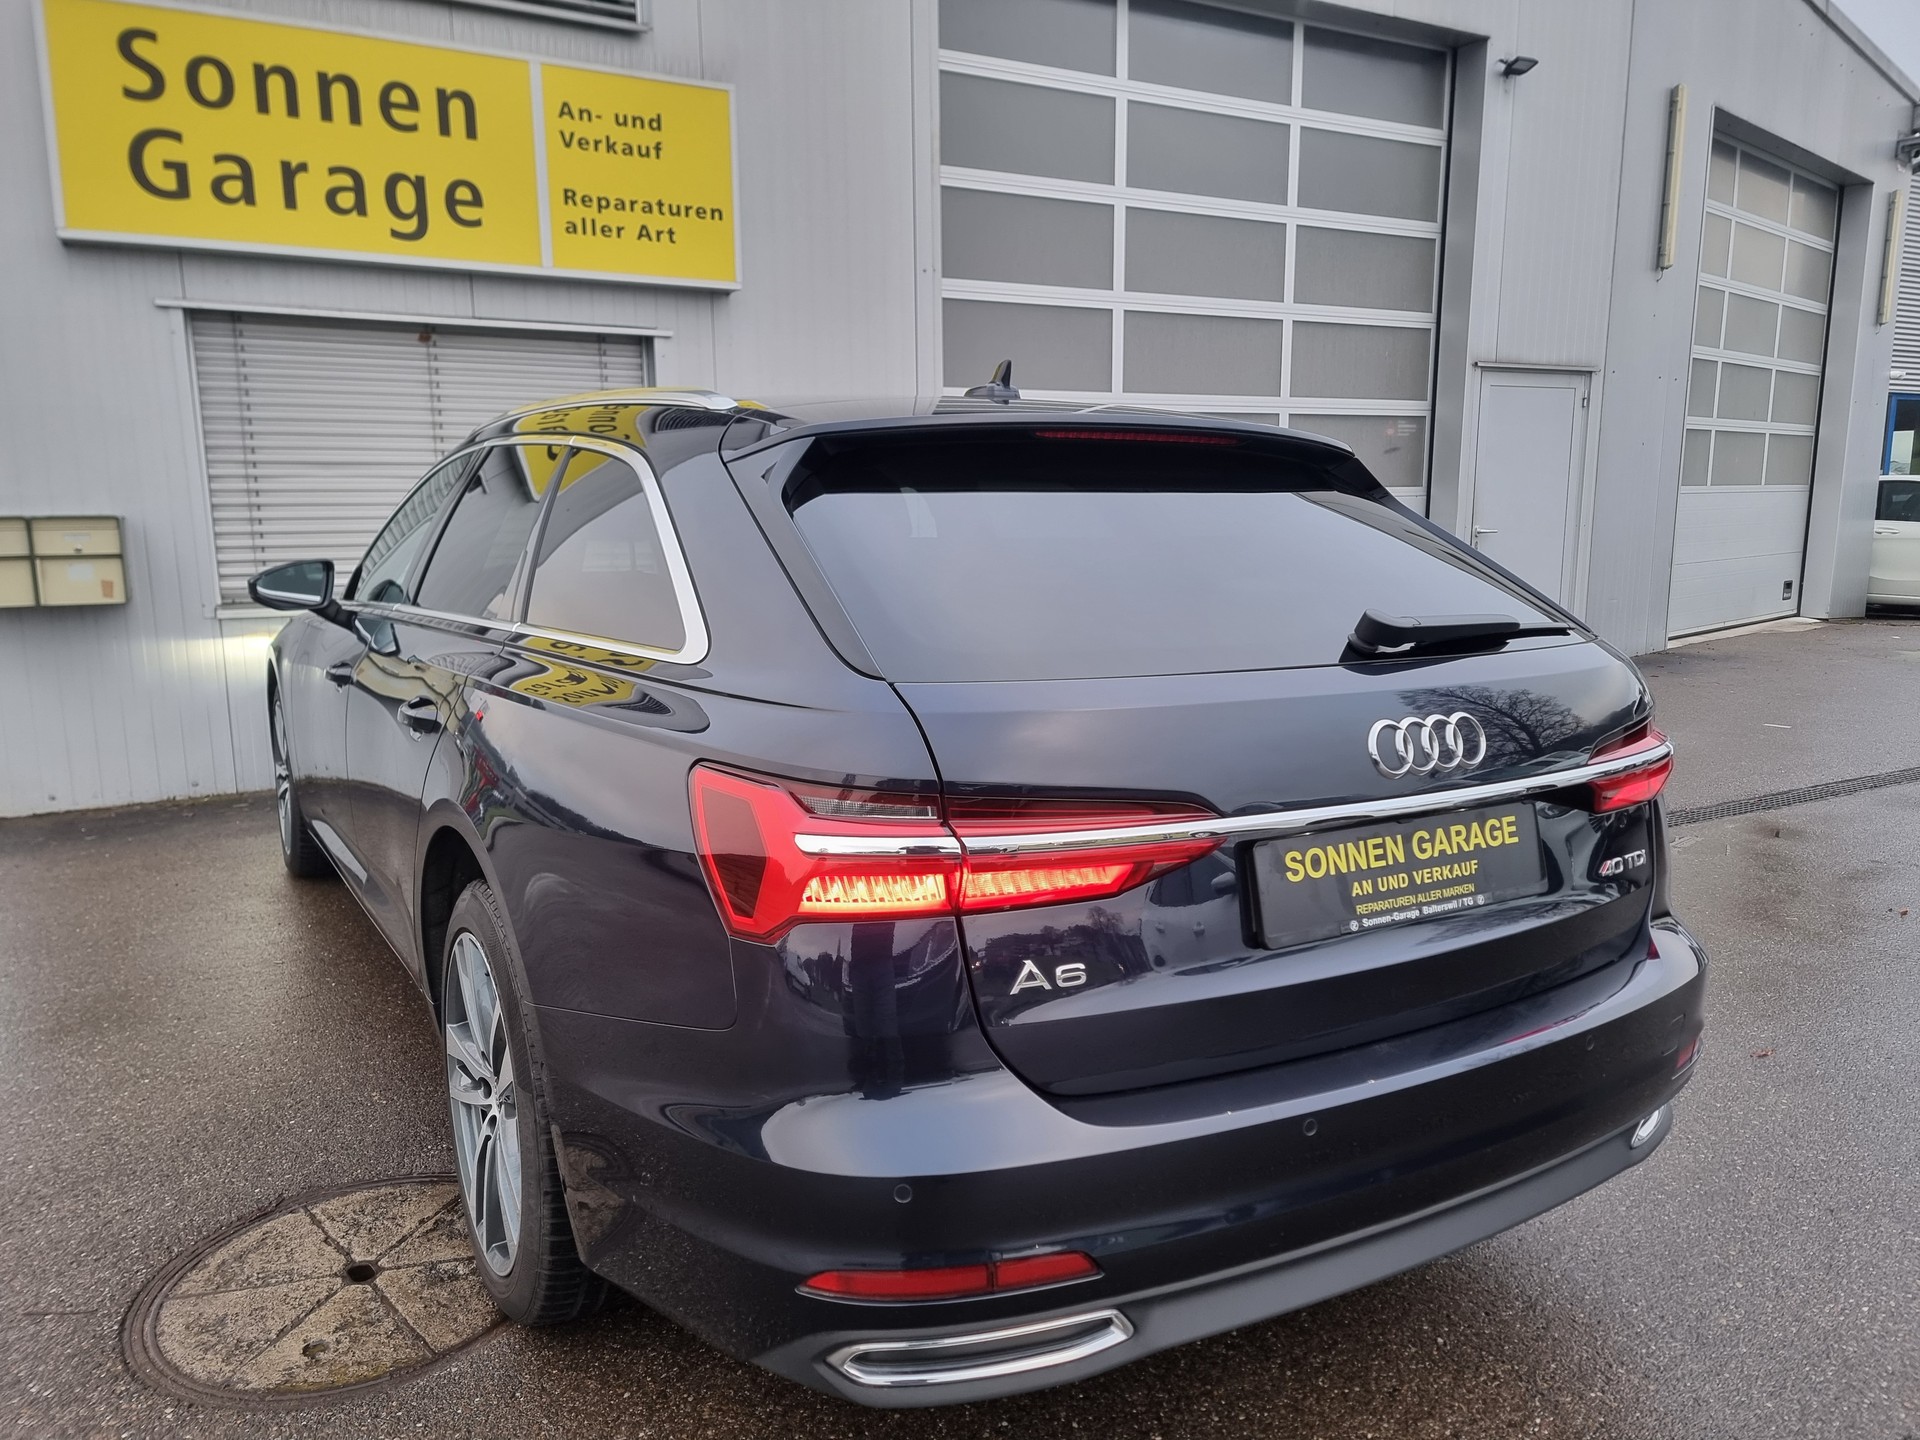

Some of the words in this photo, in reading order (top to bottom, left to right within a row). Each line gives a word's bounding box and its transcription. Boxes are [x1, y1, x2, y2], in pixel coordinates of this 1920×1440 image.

[116, 26, 478, 141] Sonnen
[558, 101, 602, 123] An-
[614, 112, 663, 132] und
[559, 129, 663, 160] Verkauf
[127, 127, 484, 242] Garage
[563, 188, 724, 221] Reparaturen
[565, 217, 625, 239] aller
[637, 224, 677, 244] Art
[1284, 834, 1406, 883] SONNEN
[1412, 815, 1519, 860] GARAGE
[1351, 879, 1373, 897] AN
[1377, 872, 1409, 892] UND
[1412, 860, 1479, 885] VERKAUF
[1598, 856, 1624, 877] 40
[1356, 894, 1416, 916] REPARATUREN
[1417, 889, 1442, 904] ALLER
[1443, 883, 1475, 898] MARKEN
[1362, 908, 1420, 928] Sonnen-Garage
[1463, 897, 1474, 906] TG
[1009, 959, 1087, 995] A6
